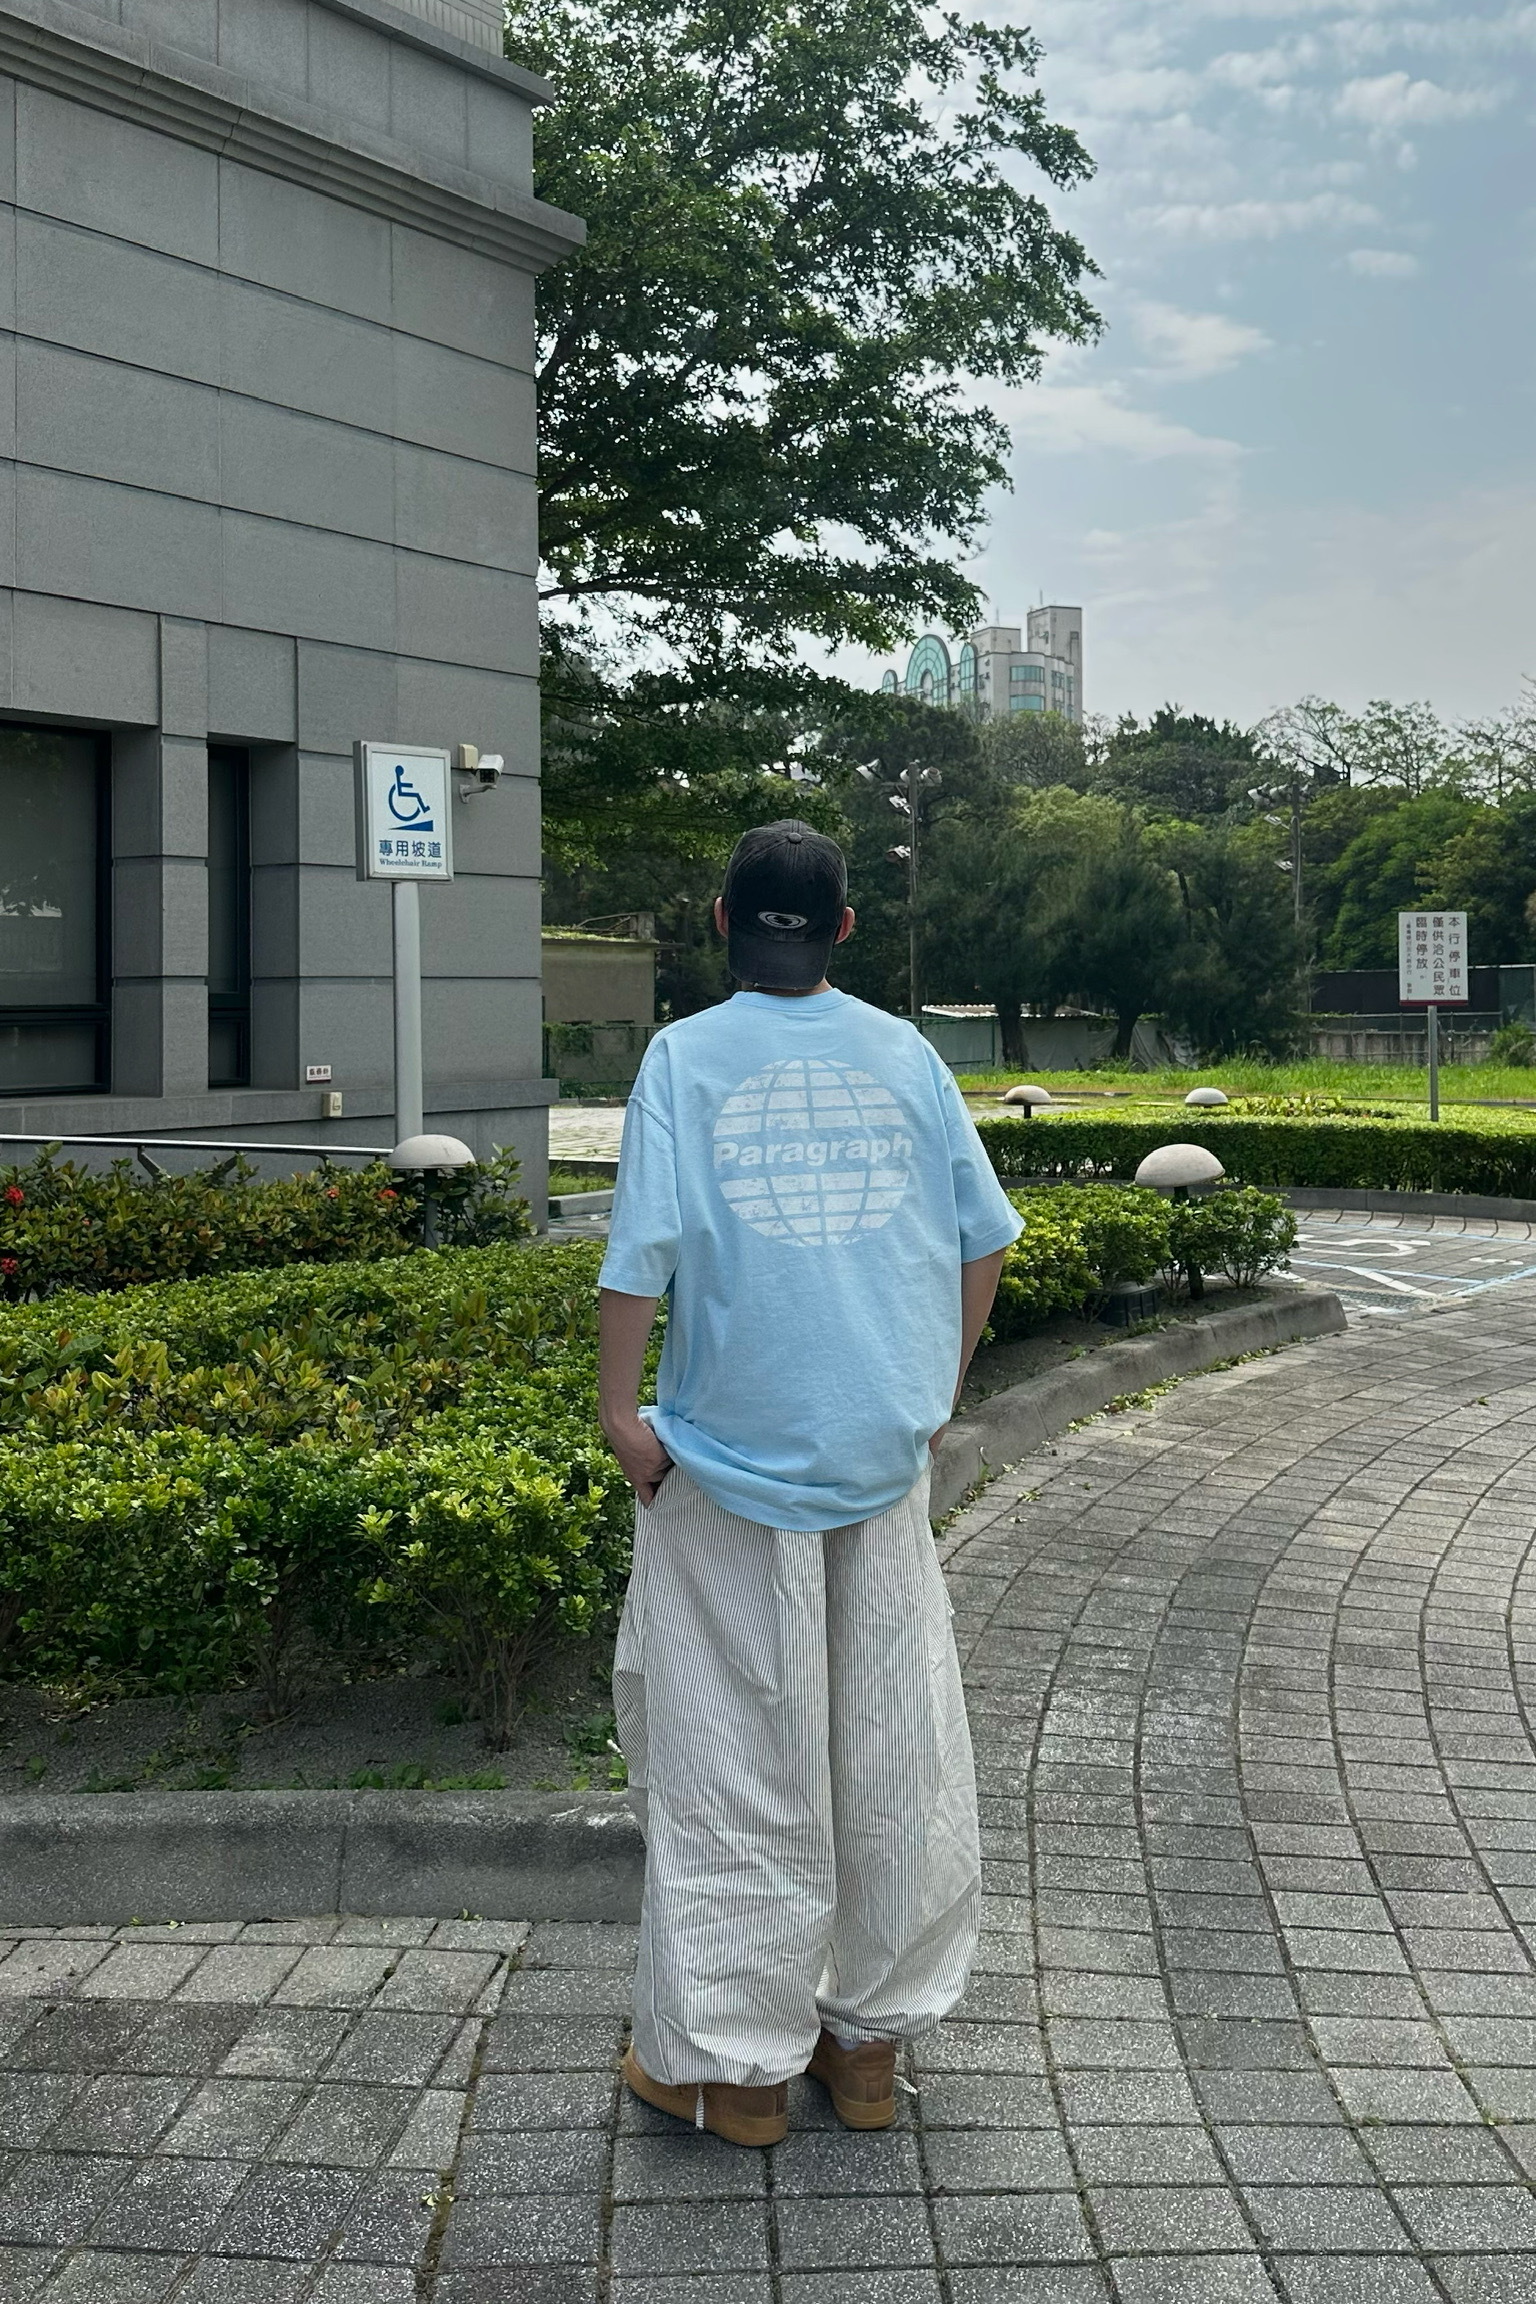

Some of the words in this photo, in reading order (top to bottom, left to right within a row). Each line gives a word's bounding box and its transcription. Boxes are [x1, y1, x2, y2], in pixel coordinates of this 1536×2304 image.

[379, 839, 442, 858] 專用坡道
[379, 859, 420, 867] Wheelchair
[421, 860, 442, 868] Ramp
[1432, 916, 1446, 996] 僅供洽公民眾
[1448, 916, 1461, 996] 本行停車位
[713, 1132, 914, 1170] Paragraph
